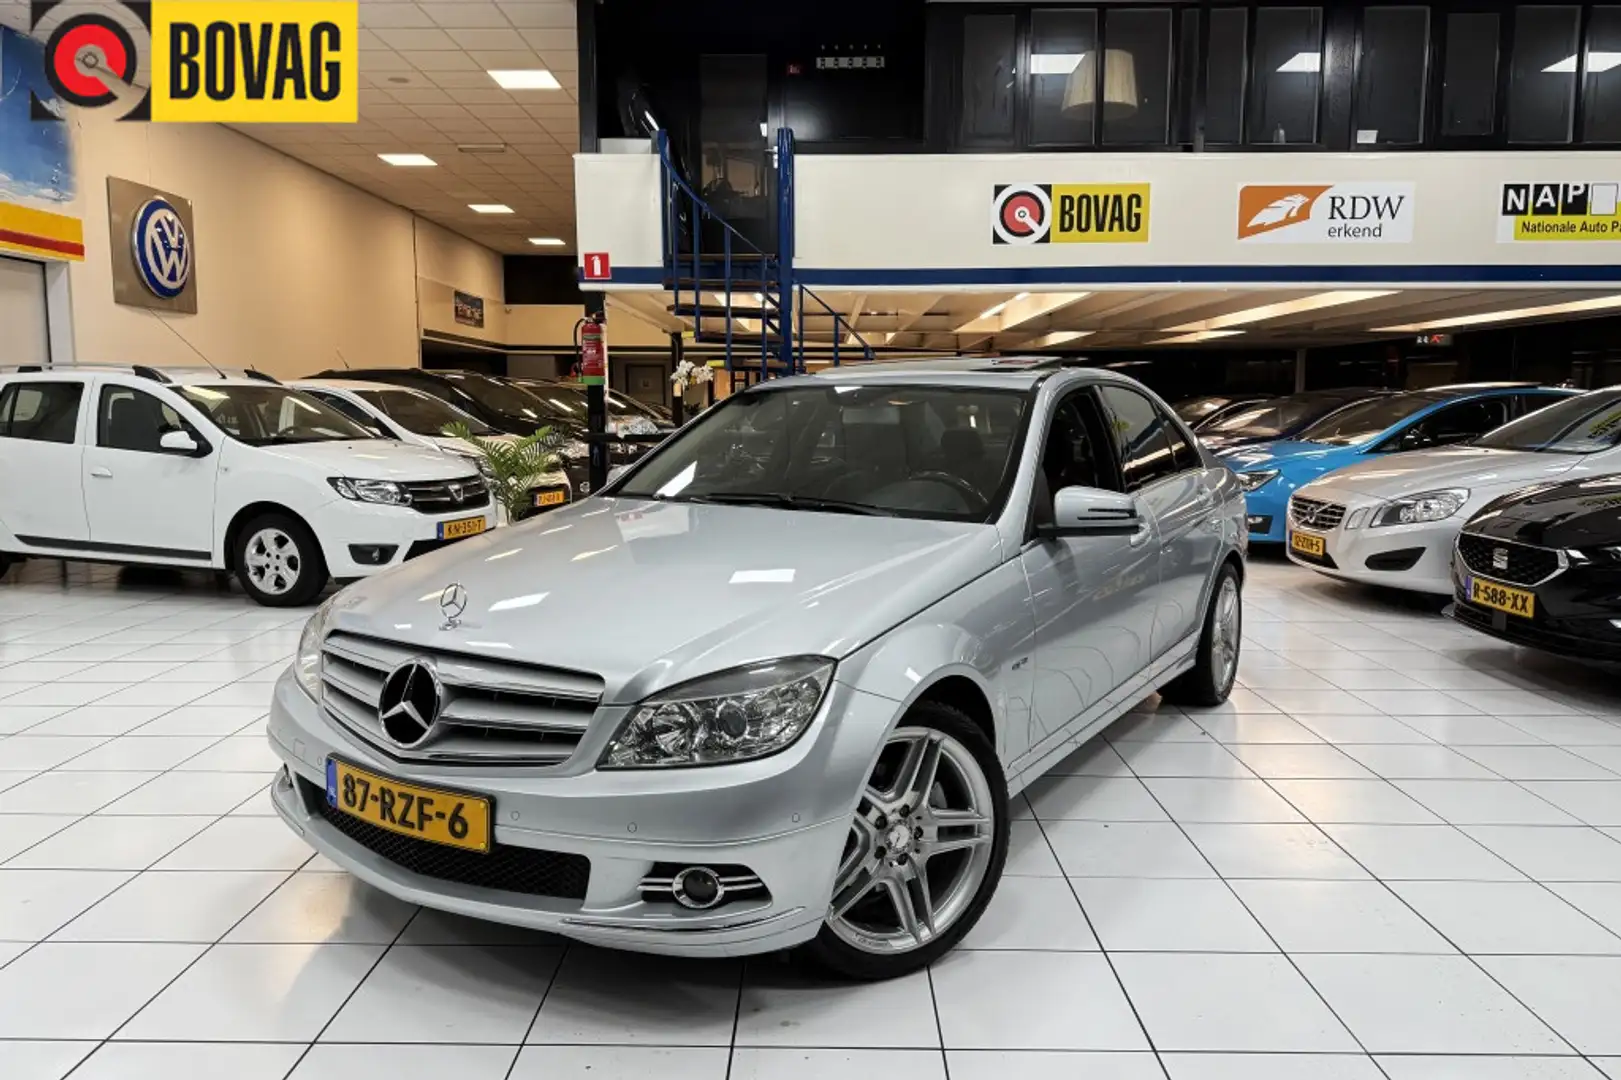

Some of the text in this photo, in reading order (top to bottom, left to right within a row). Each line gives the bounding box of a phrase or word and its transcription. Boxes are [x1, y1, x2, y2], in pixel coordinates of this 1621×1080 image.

[1328, 195, 1405, 220] RDW
[1506, 184, 1586, 212] NAP
[1059, 193, 1142, 233] BOVAG
[1521, 221, 1577, 233] Nationale
[1580, 221, 1608, 233] Auto
[1328, 223, 1382, 238] erkend
[1473, 581, 1530, 614] R-588-XX
[343, 772, 469, 840] 87-RZF-6
